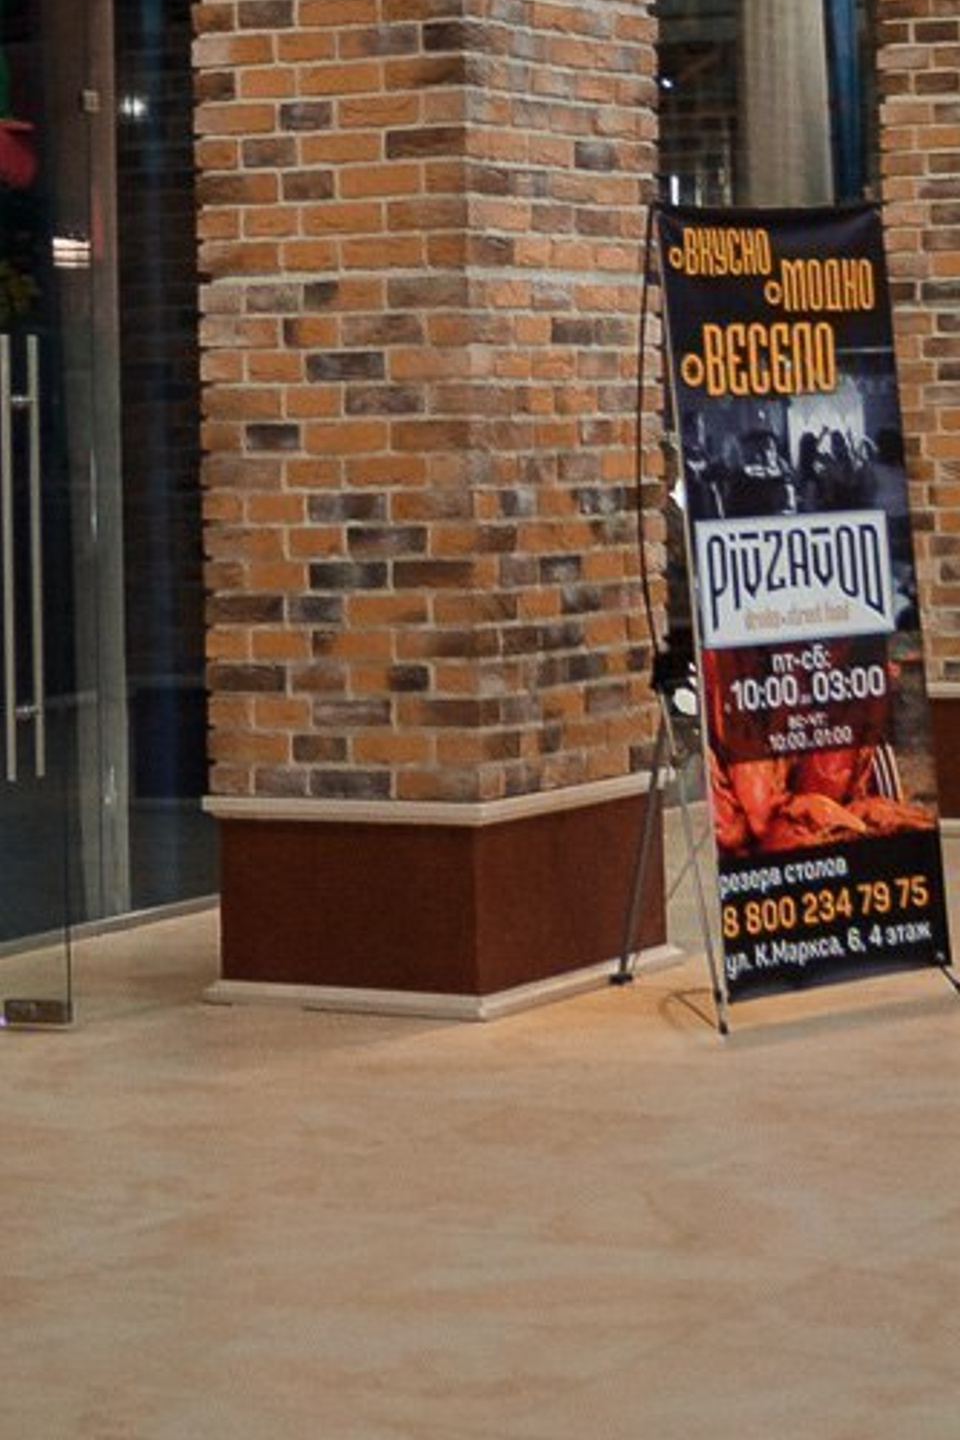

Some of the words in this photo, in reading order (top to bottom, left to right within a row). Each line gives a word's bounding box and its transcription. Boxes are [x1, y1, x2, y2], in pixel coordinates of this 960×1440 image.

[683, 227, 771, 276] ВКУСНО
[781, 258, 875, 311] МОДНО
[703, 322, 836, 396] ВЕСЕЛО
[730, 675, 799, 711] 10:00
[812, 665, 887, 702] 03:00
[723, 906, 740, 938] 8
[745, 896, 798, 935] 800
[803, 887, 852, 924] 234
[857, 880, 892, 914] 79
[895, 875, 929, 908] 75
[869, 923, 882, 947] 4
[885, 921, 932, 946] этаж
